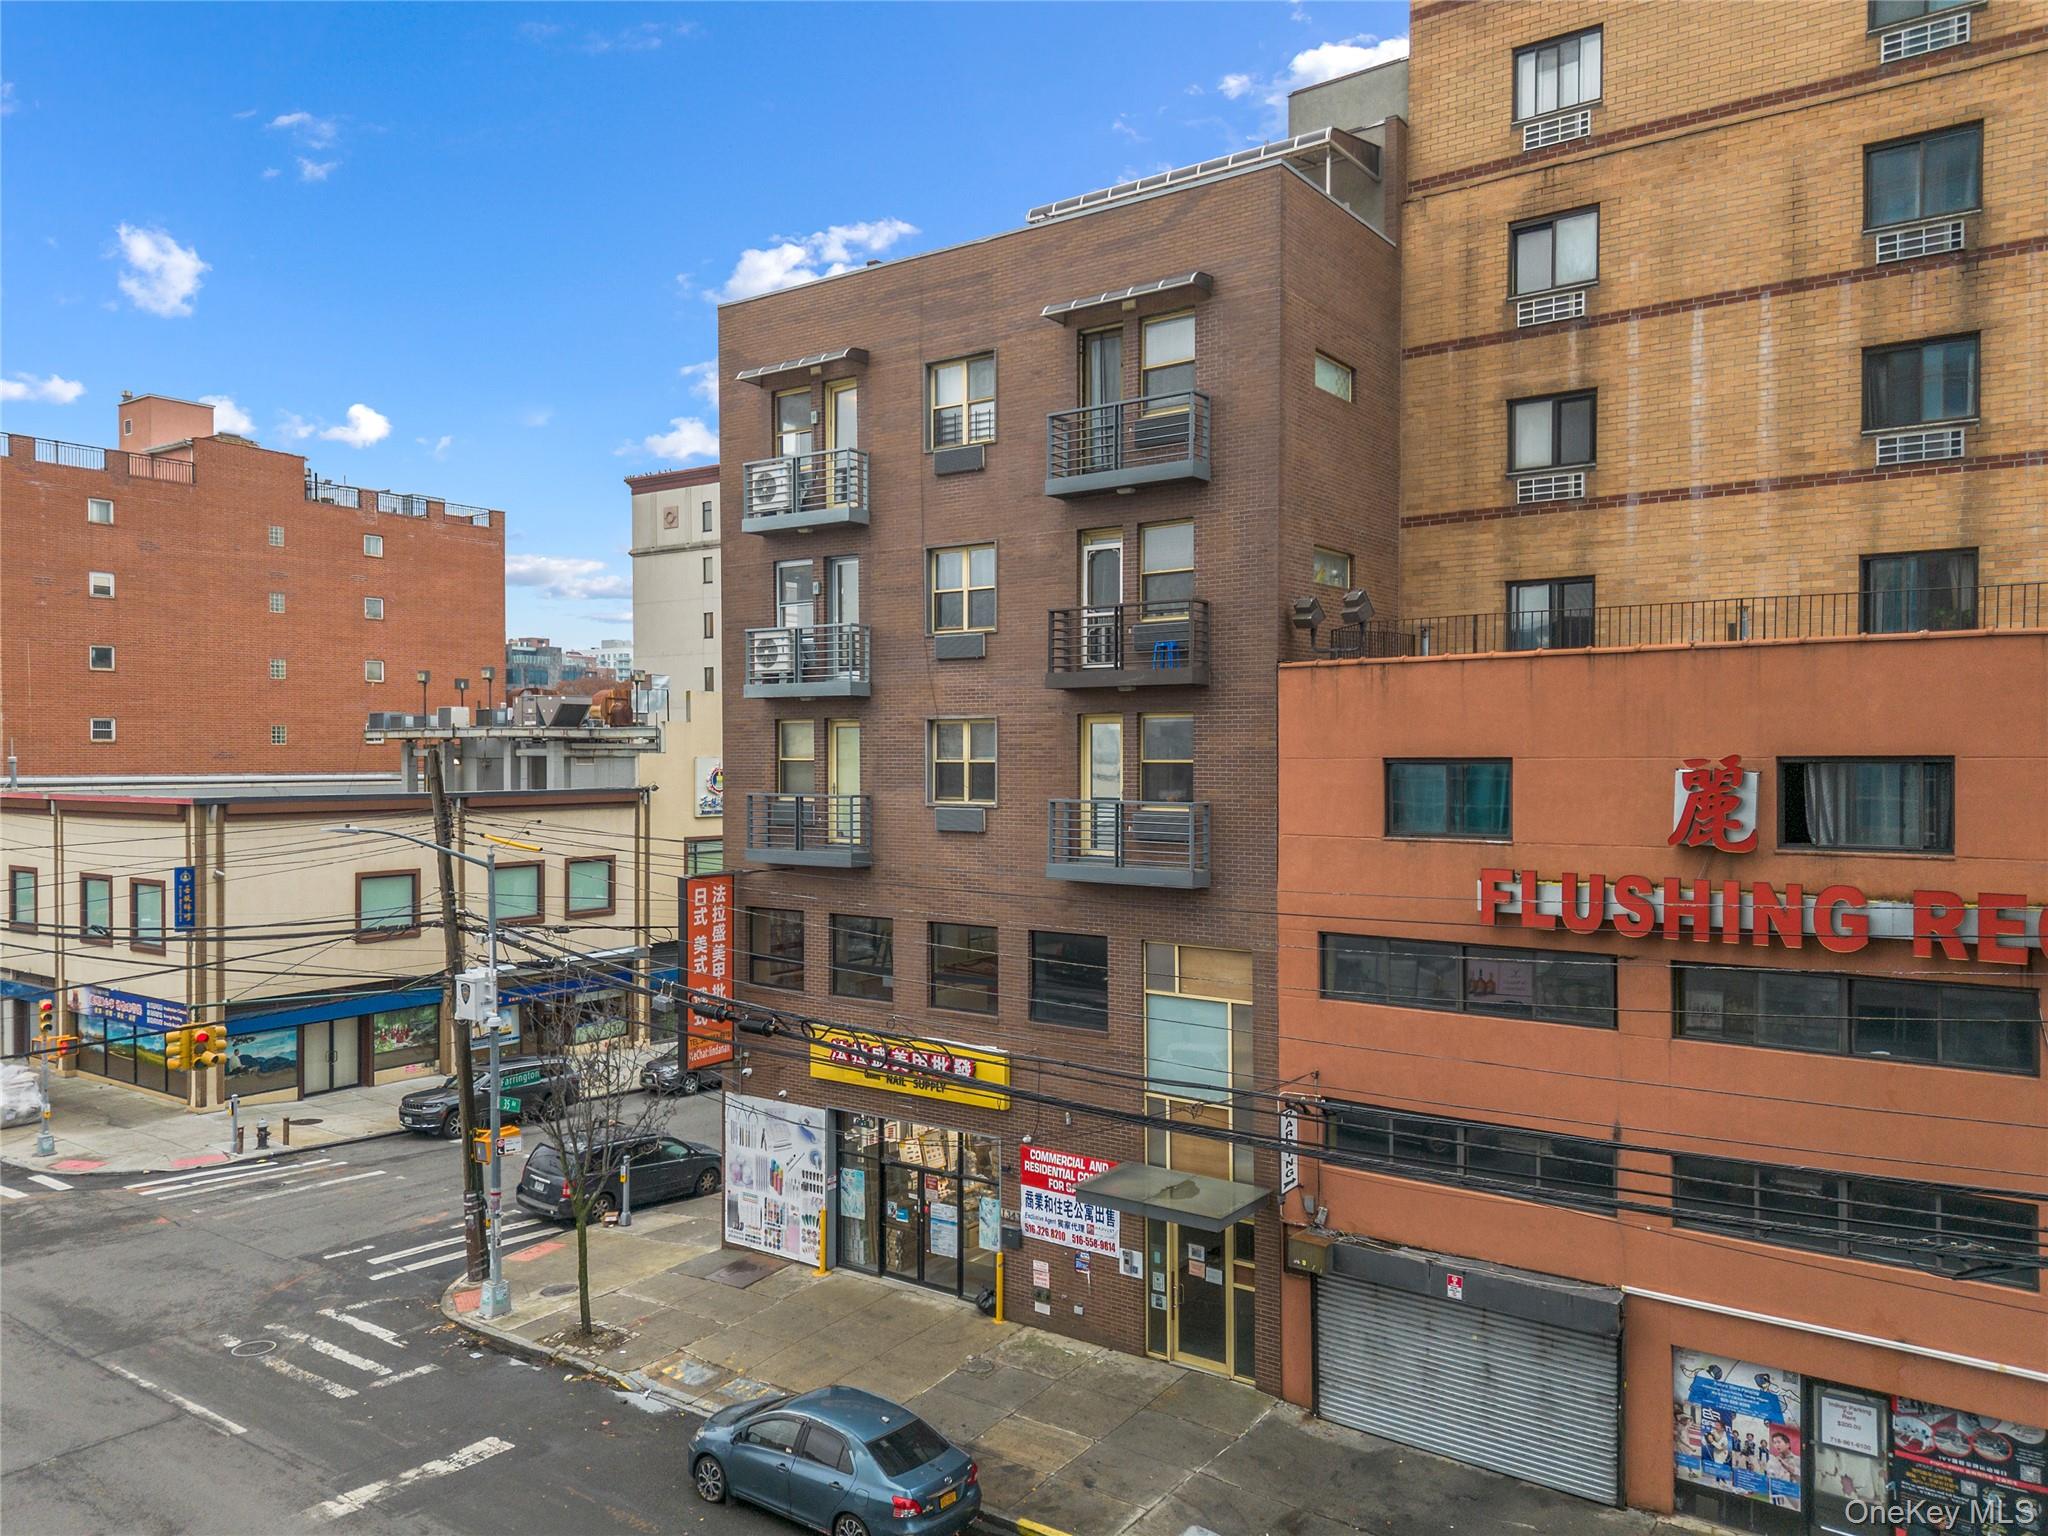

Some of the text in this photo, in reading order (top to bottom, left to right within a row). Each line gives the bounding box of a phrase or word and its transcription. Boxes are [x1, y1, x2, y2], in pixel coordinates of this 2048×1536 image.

[1668, 754, 1759, 853] 麗
[1480, 868, 2048, 964] FLUSHING RE
[501, 1070, 541, 1087] Farrington
[886, 1075, 906, 1087] NAIL
[913, 1079, 947, 1093] SUPPLY
[503, 1098, 510, 1110] 35
[1024, 1160, 1076, 1181] RESIDENTIAL
[1029, 1149, 1109, 1173] COMMERCIAL AND
[1048, 1179, 1064, 1192] FOR
[1025, 1190, 1115, 1228] 商業和住宅公寓出售
